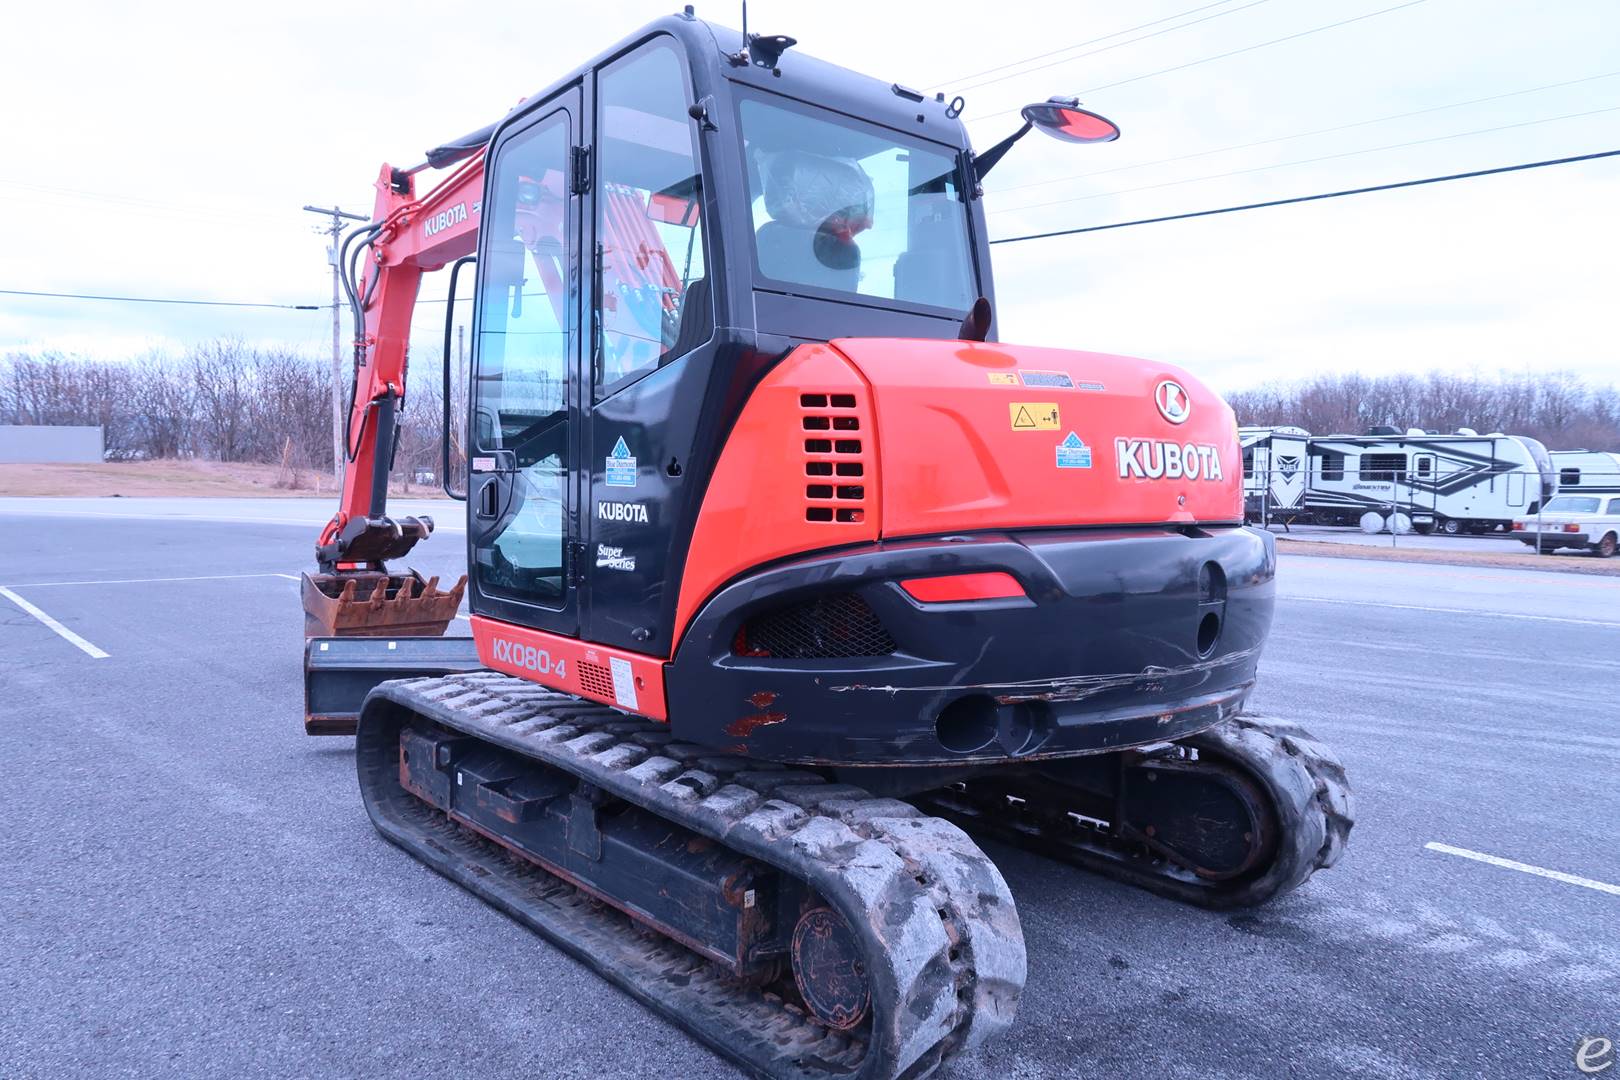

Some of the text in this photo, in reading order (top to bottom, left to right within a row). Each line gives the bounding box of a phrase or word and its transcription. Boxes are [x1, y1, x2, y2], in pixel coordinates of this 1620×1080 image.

[424, 203, 468, 238] KUBOTA
[1116, 439, 1223, 481] KUBOTA
[598, 502, 648, 523] KUBOTA
[597, 543, 624, 559] Super
[608, 556, 636, 571] Series
[493, 637, 567, 680] KX080-4
